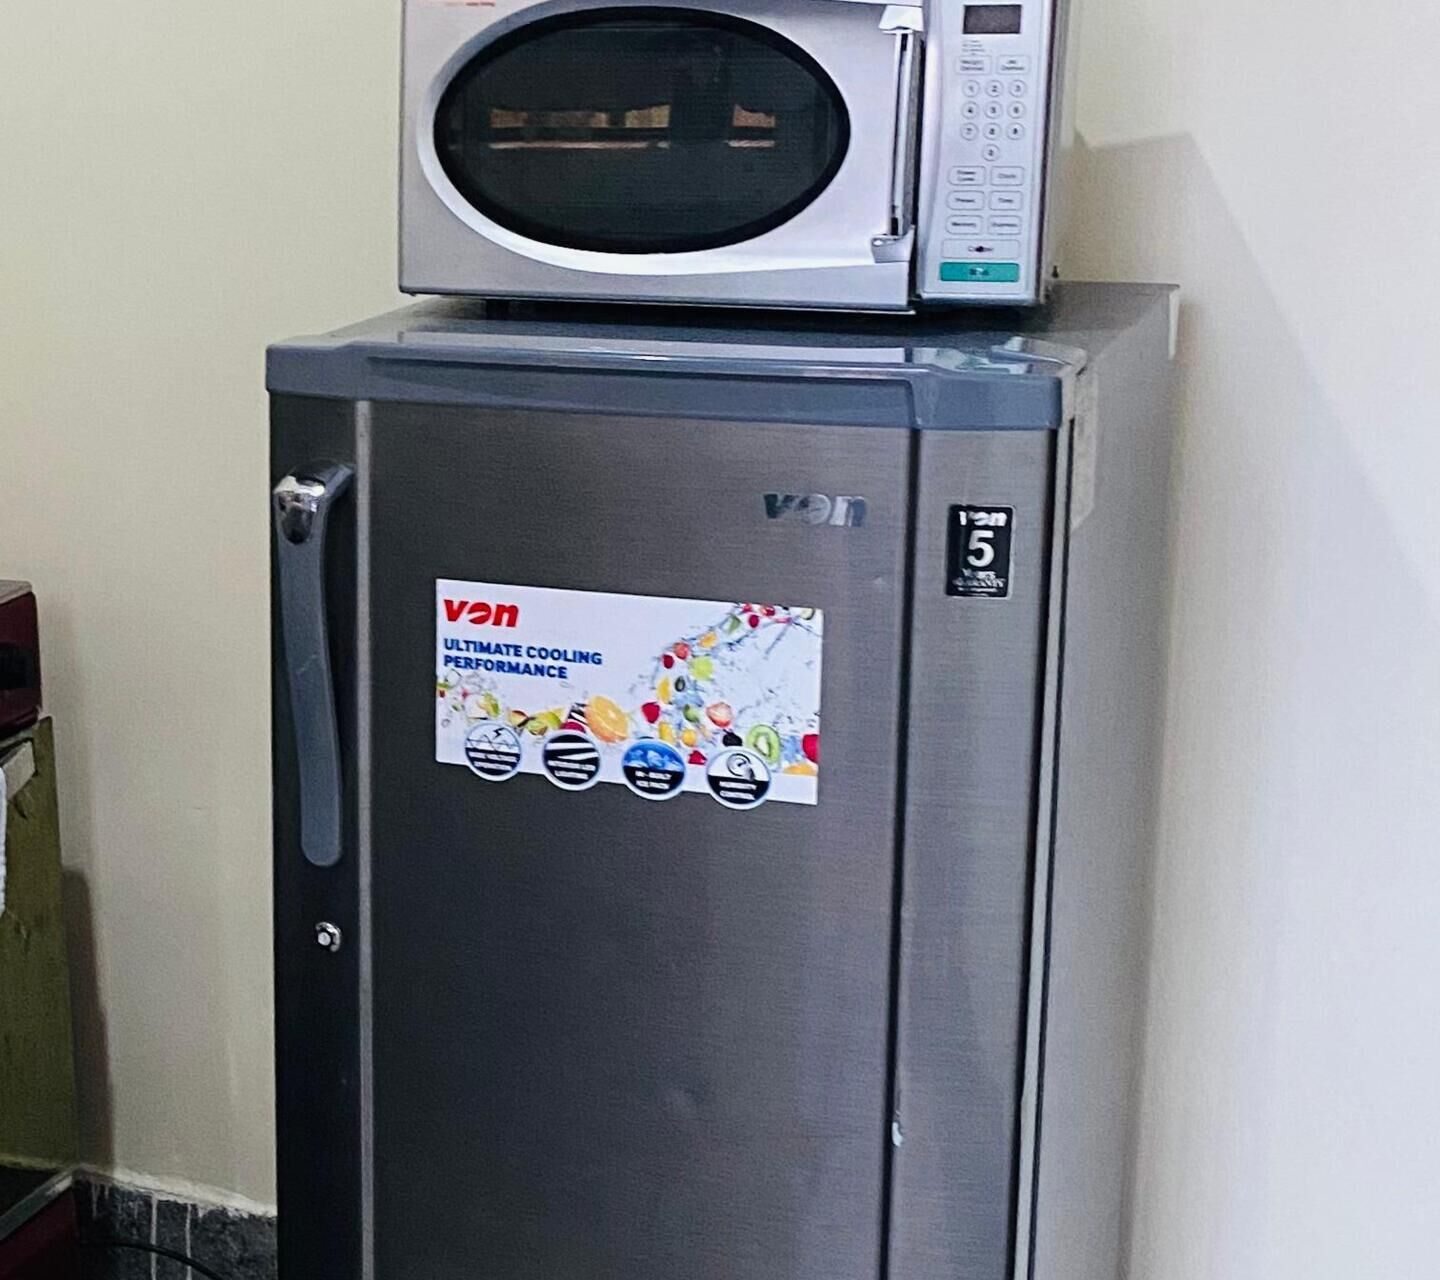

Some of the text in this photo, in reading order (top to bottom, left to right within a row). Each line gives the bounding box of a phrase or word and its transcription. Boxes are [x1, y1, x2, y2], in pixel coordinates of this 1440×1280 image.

[966, 529, 995, 568] 5
[443, 598, 520, 628] von
[443, 638, 603, 665] ULTIMATE COOLING
[443, 654, 568, 679] PERFORMANCE
